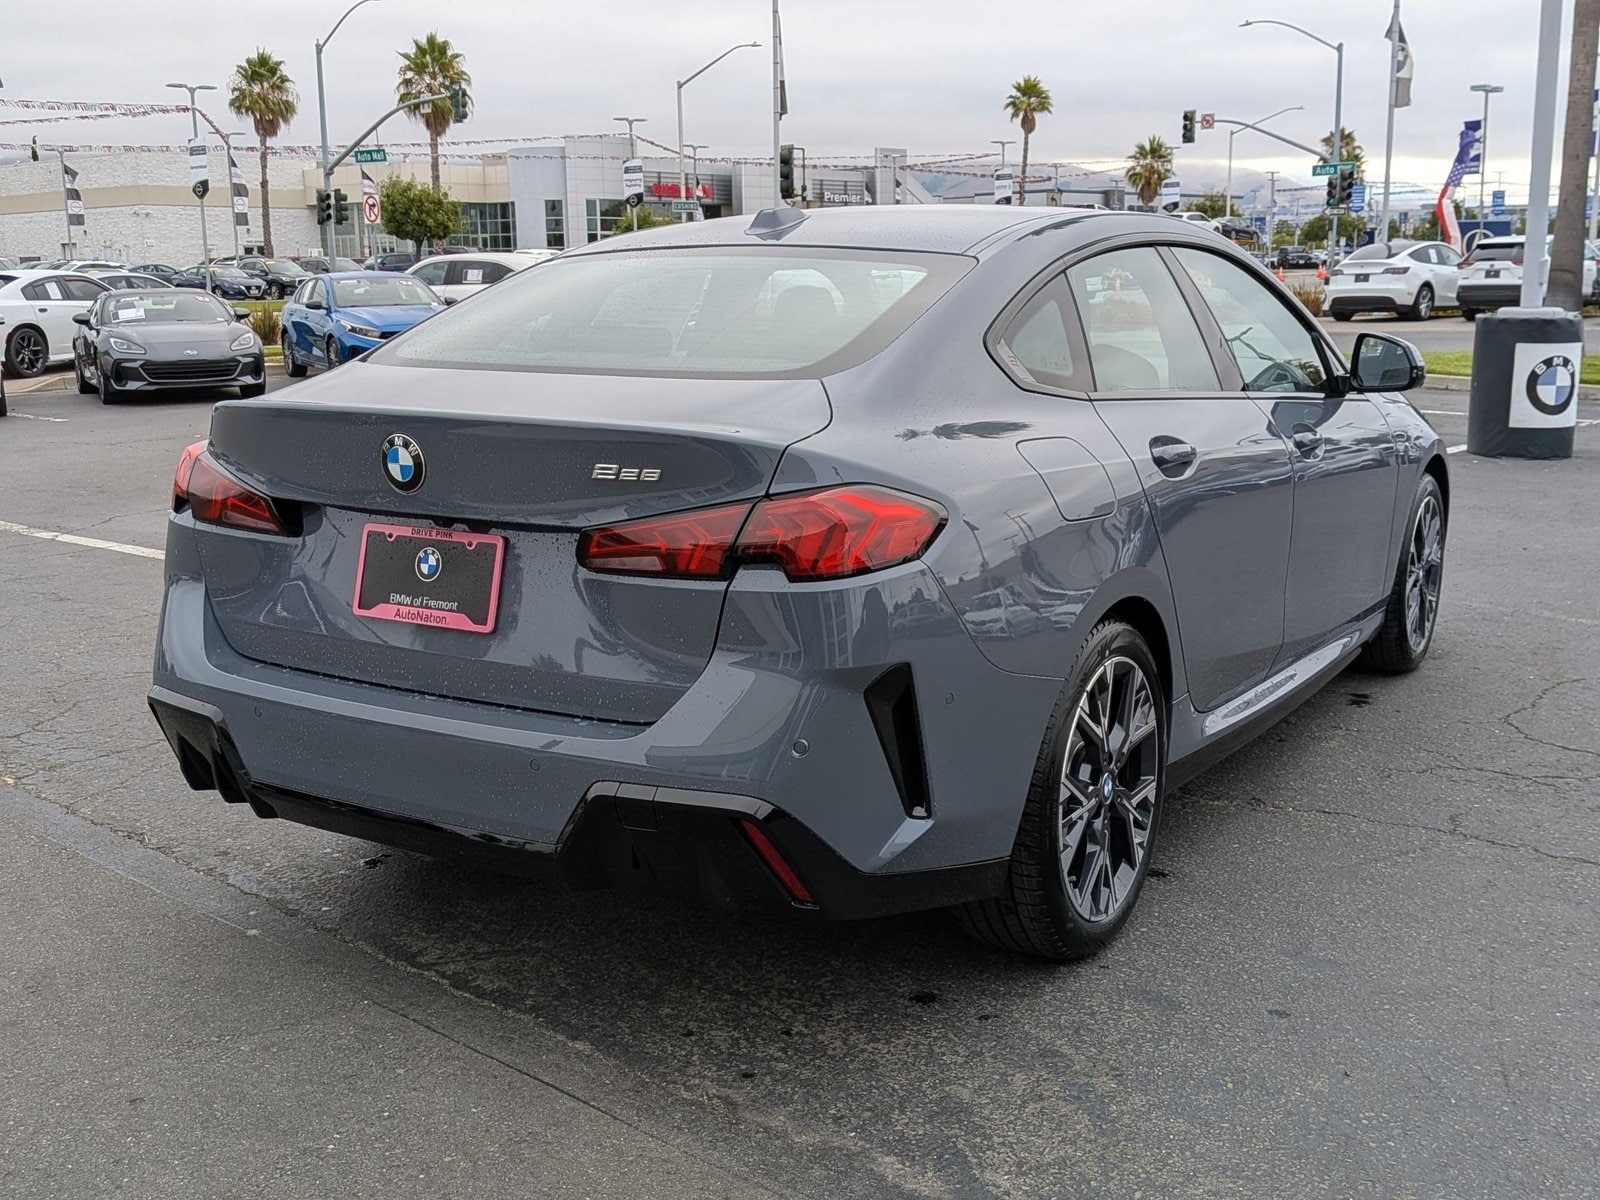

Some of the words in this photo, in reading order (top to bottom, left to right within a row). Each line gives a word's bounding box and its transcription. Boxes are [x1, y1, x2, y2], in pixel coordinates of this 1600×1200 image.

[1315, 165, 1335, 175] Auto
[824, 191, 862, 203] Premier
[383, 436, 419, 456] BMW
[591, 463, 662, 481] 228
[411, 528, 433, 537] DRIVE
[435, 530, 454, 539] PINK
[390, 591, 412, 605] BMW
[413, 596, 423, 606] of
[422, 597, 458, 610] Fremont
[394, 608, 448, 625] AutoNation
